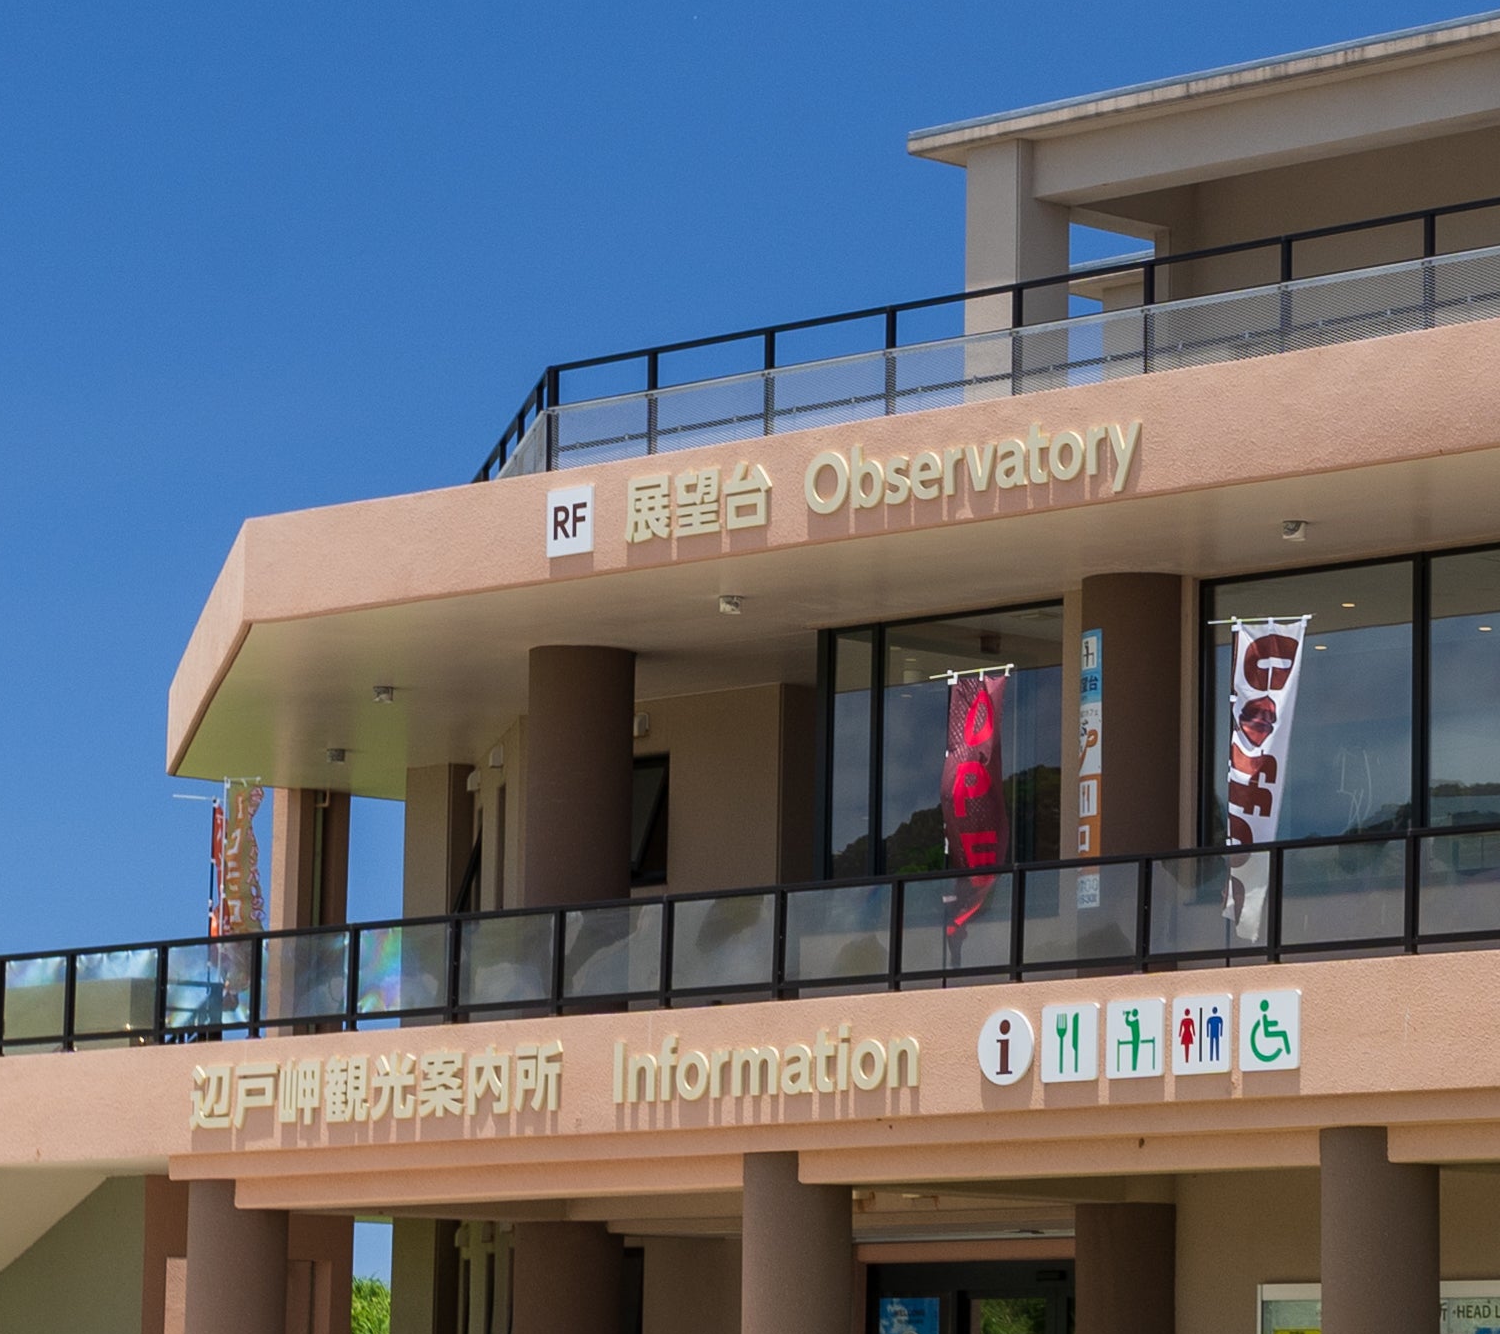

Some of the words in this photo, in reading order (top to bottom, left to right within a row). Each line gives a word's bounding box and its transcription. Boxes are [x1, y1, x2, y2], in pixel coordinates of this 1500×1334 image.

[625, 463, 772, 544] 展望台
[804, 419, 1143, 517] Observatory
[551, 504, 589, 542] RF
[190, 1038, 563, 1130] 辺戸岬観光案内所
[614, 1025, 920, 1104] Information
[1456, 1304, 1491, 1319] HEAD
